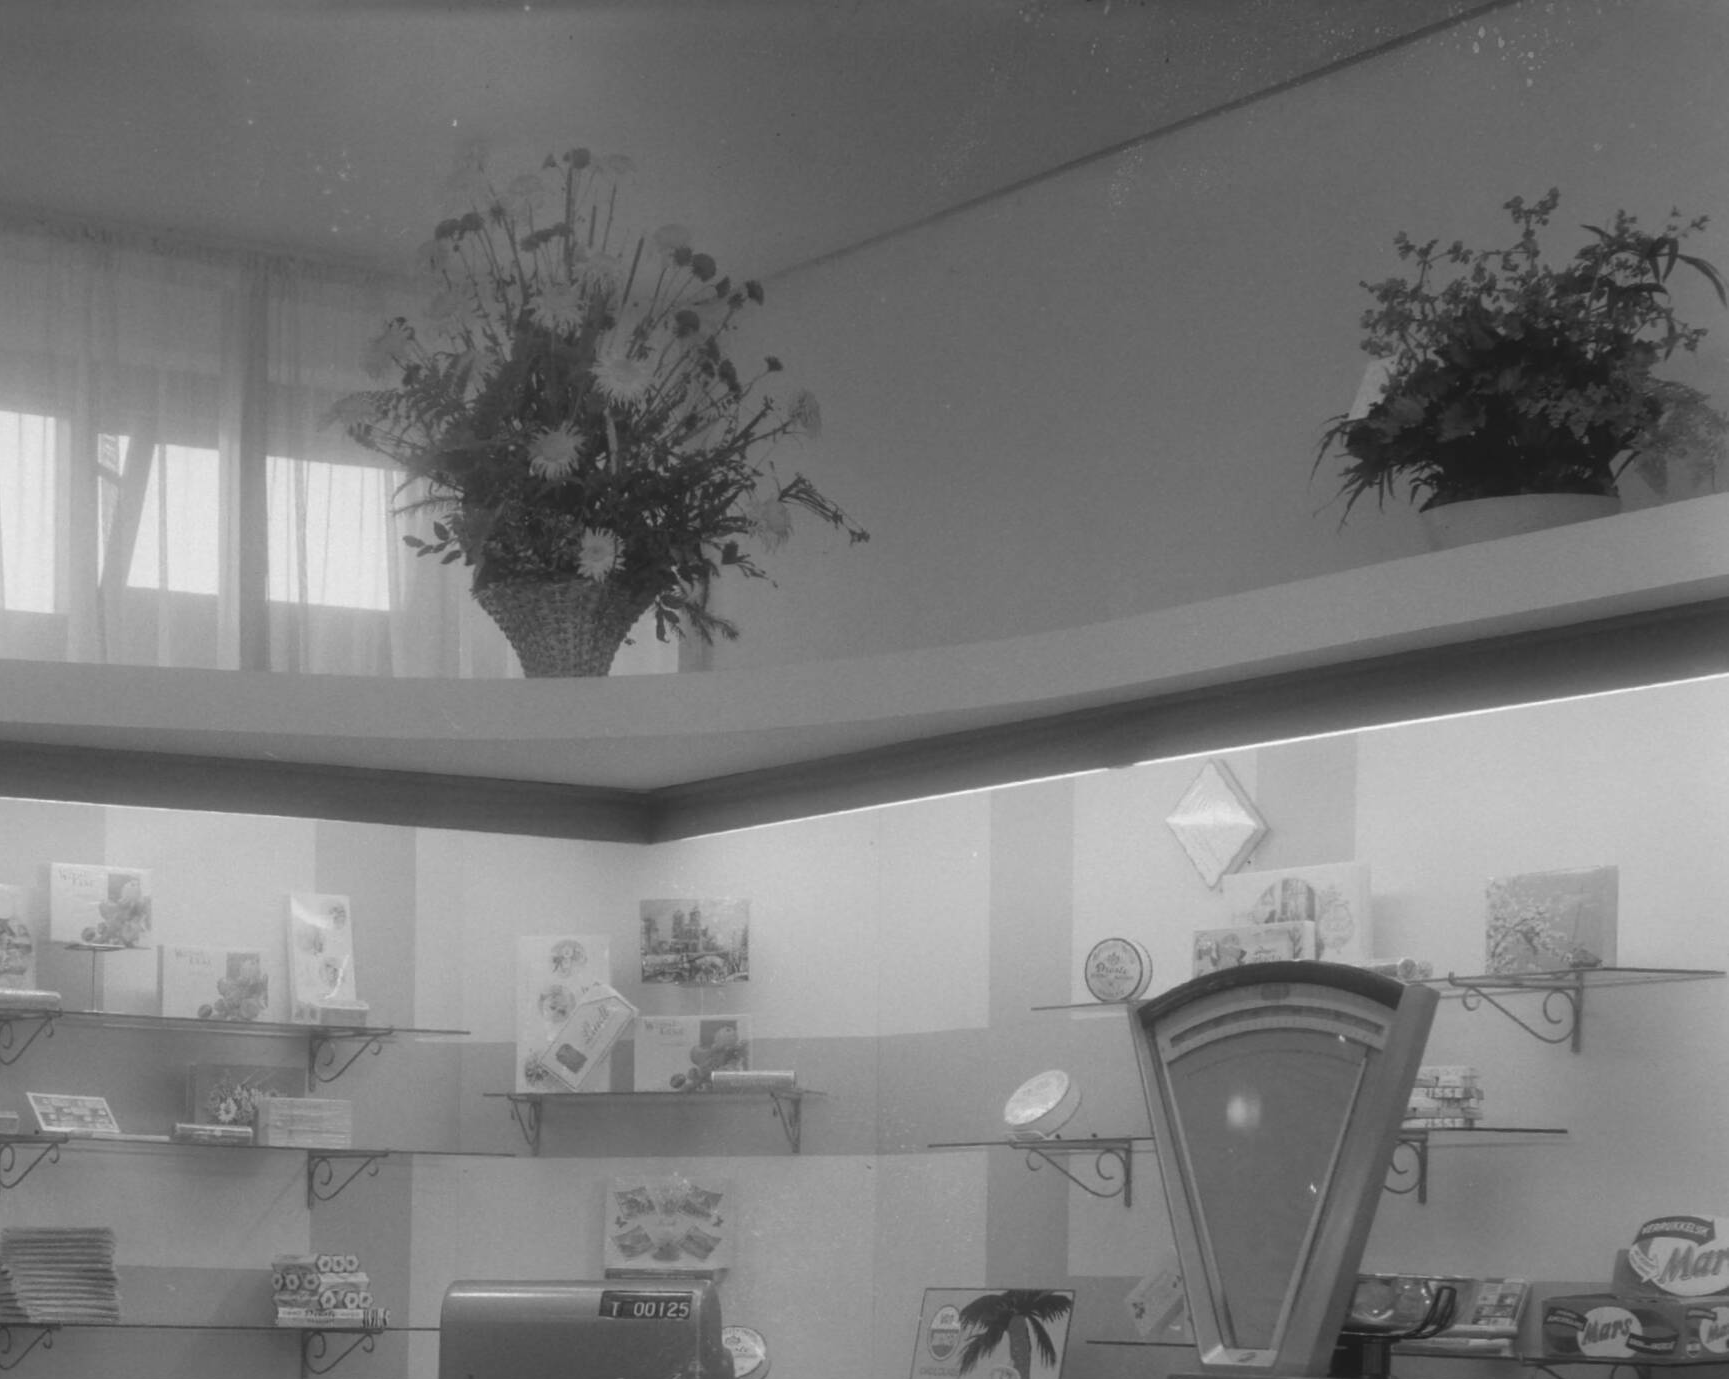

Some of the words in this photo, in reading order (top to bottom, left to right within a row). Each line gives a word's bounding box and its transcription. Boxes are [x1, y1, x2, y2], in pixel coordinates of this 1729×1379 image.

[612, 1301, 622, 1317] T
[633, 1301, 690, 1318] 00125
[1582, 1318, 1632, 1345] Mars
